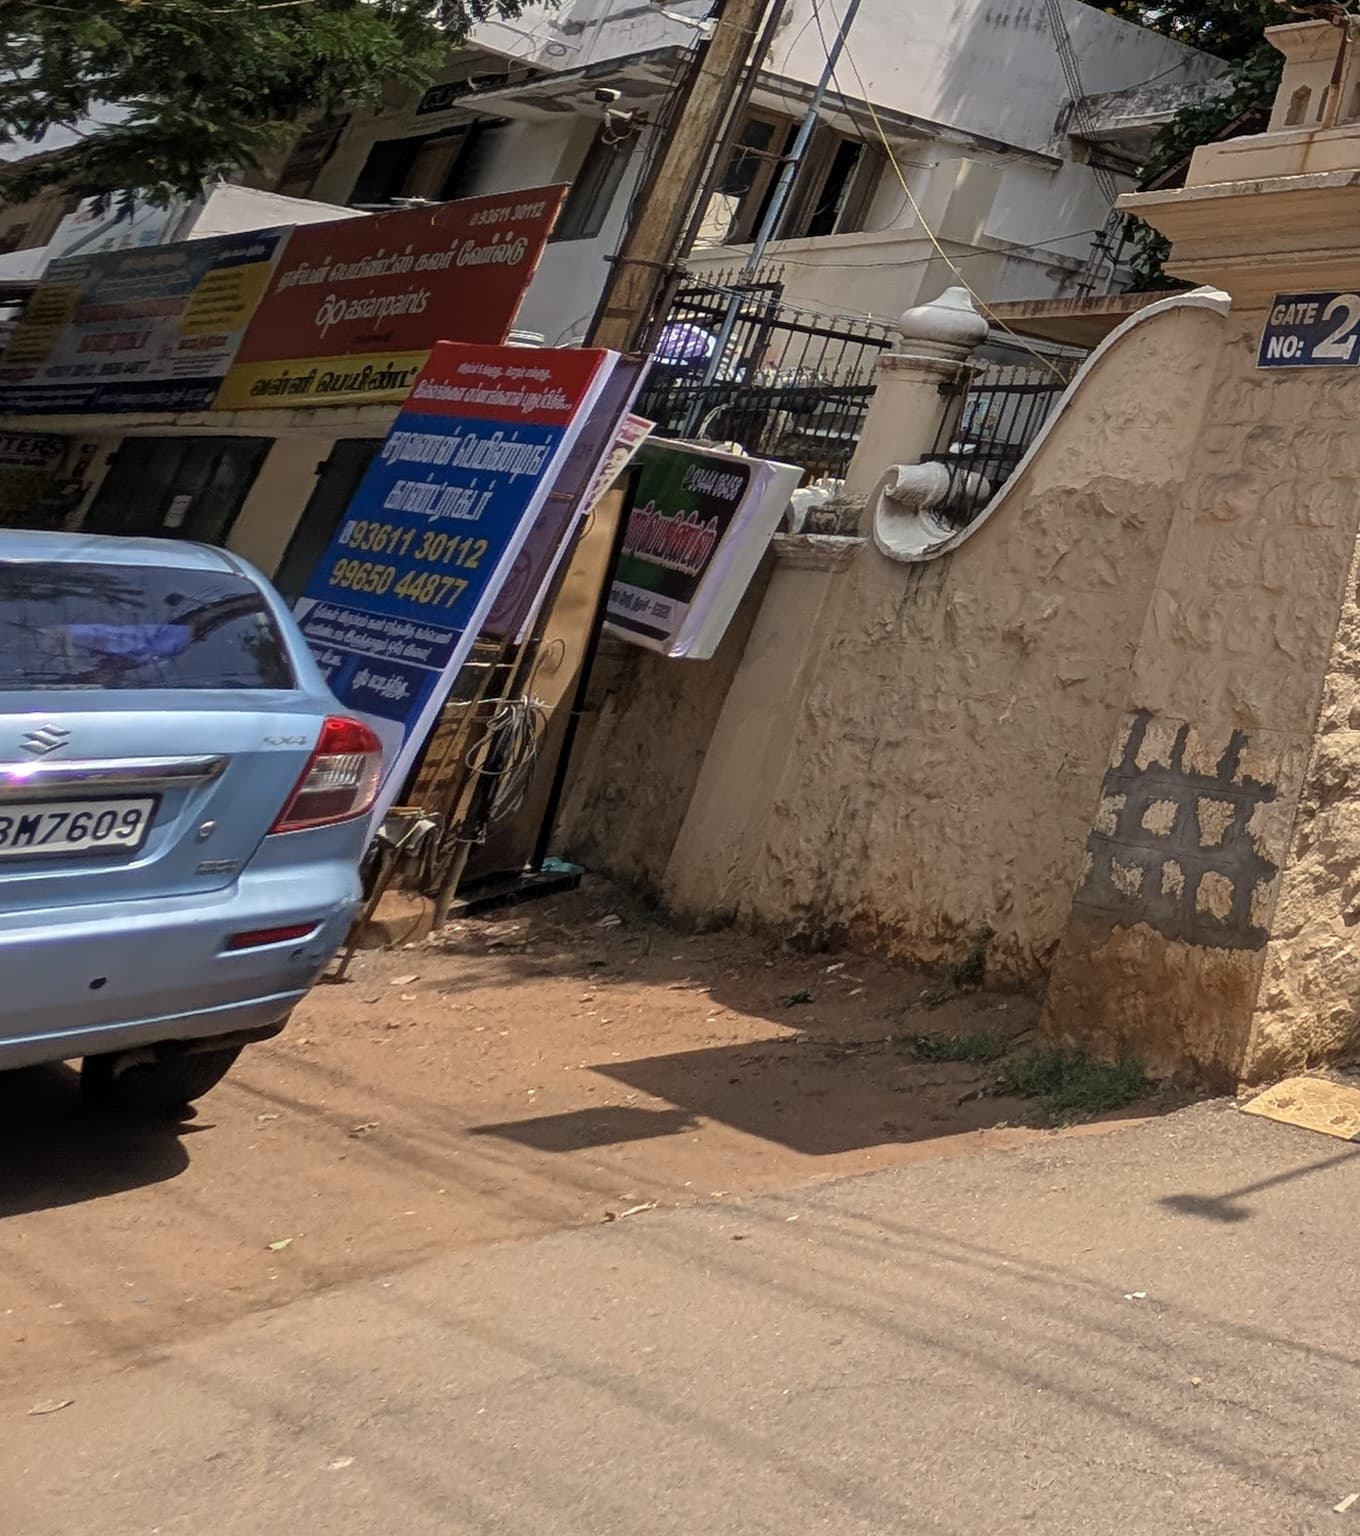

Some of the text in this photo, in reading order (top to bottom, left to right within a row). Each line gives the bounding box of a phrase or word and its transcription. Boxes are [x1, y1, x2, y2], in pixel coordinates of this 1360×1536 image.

[1270, 303, 1319, 325] GATE
[1267, 335, 1304, 358] NO:
[351, 520, 488, 568] 93611 30112
[329, 558, 468, 608] 99650 44877
